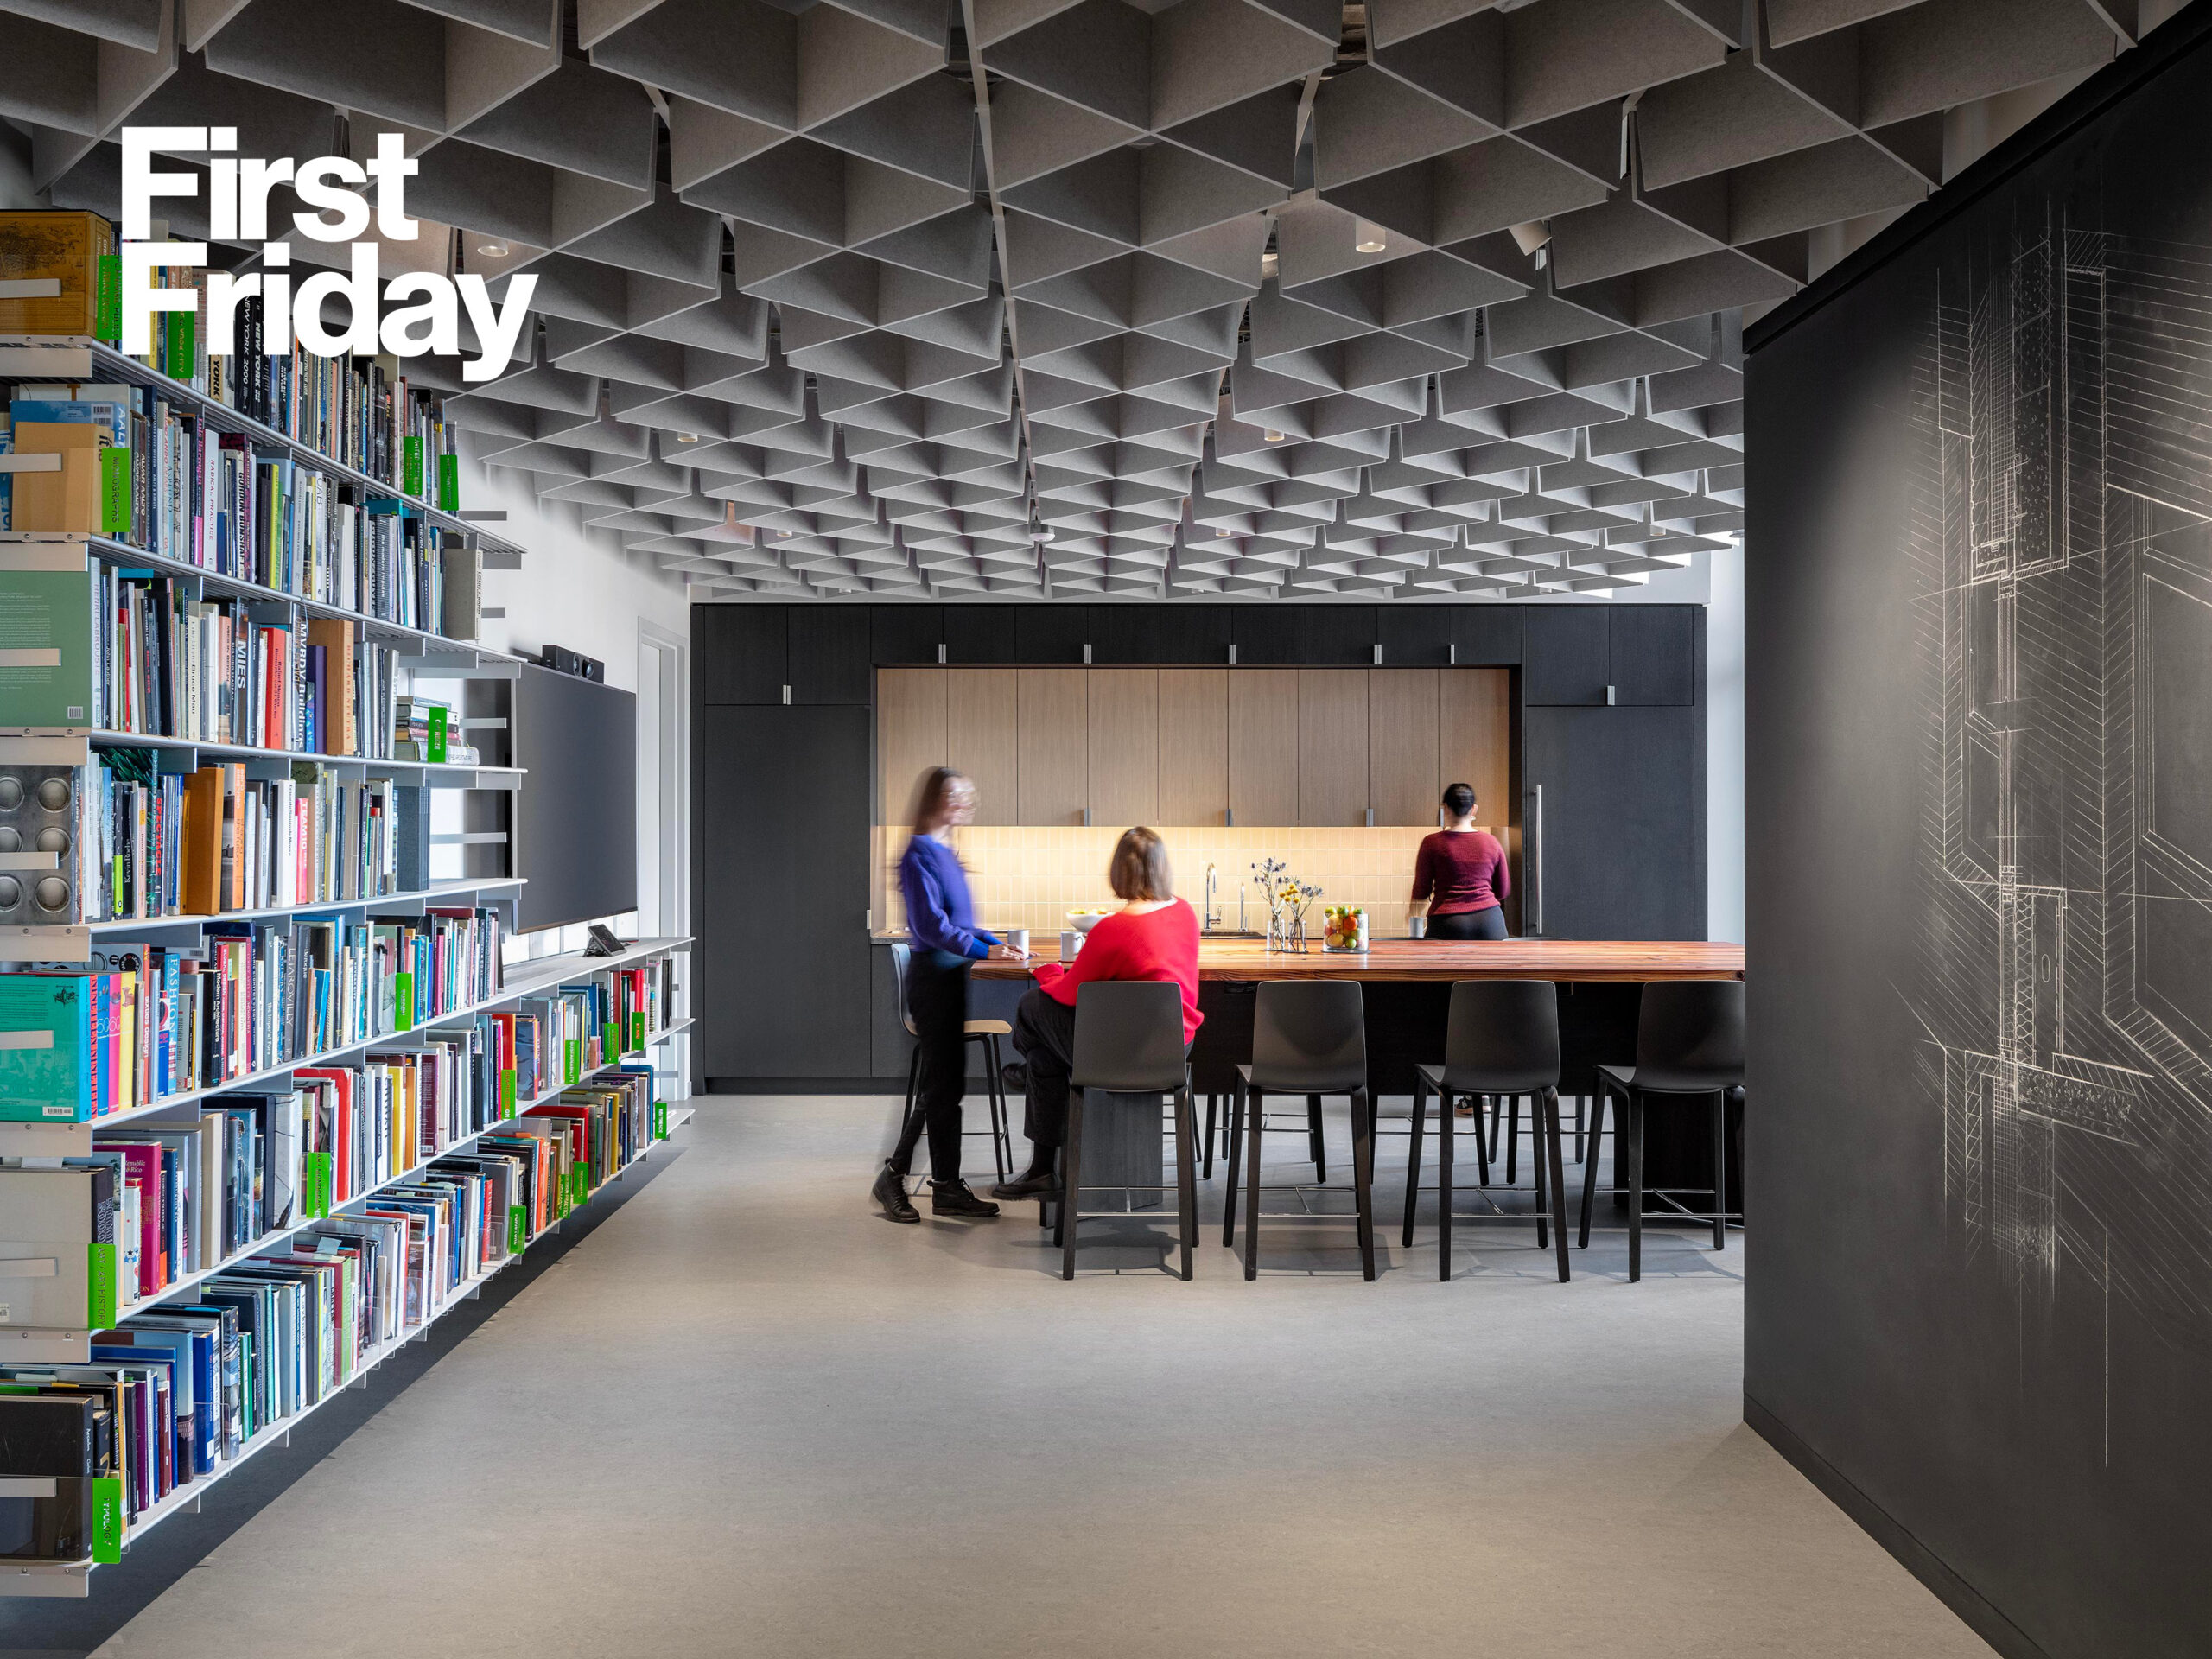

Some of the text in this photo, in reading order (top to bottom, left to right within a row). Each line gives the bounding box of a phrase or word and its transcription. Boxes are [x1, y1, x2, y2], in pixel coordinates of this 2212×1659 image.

[169, 958, 178, 1032] FASHION
[286, 948, 296, 1027] LETAROVILLY
[98, 1247, 106, 1264] ART
